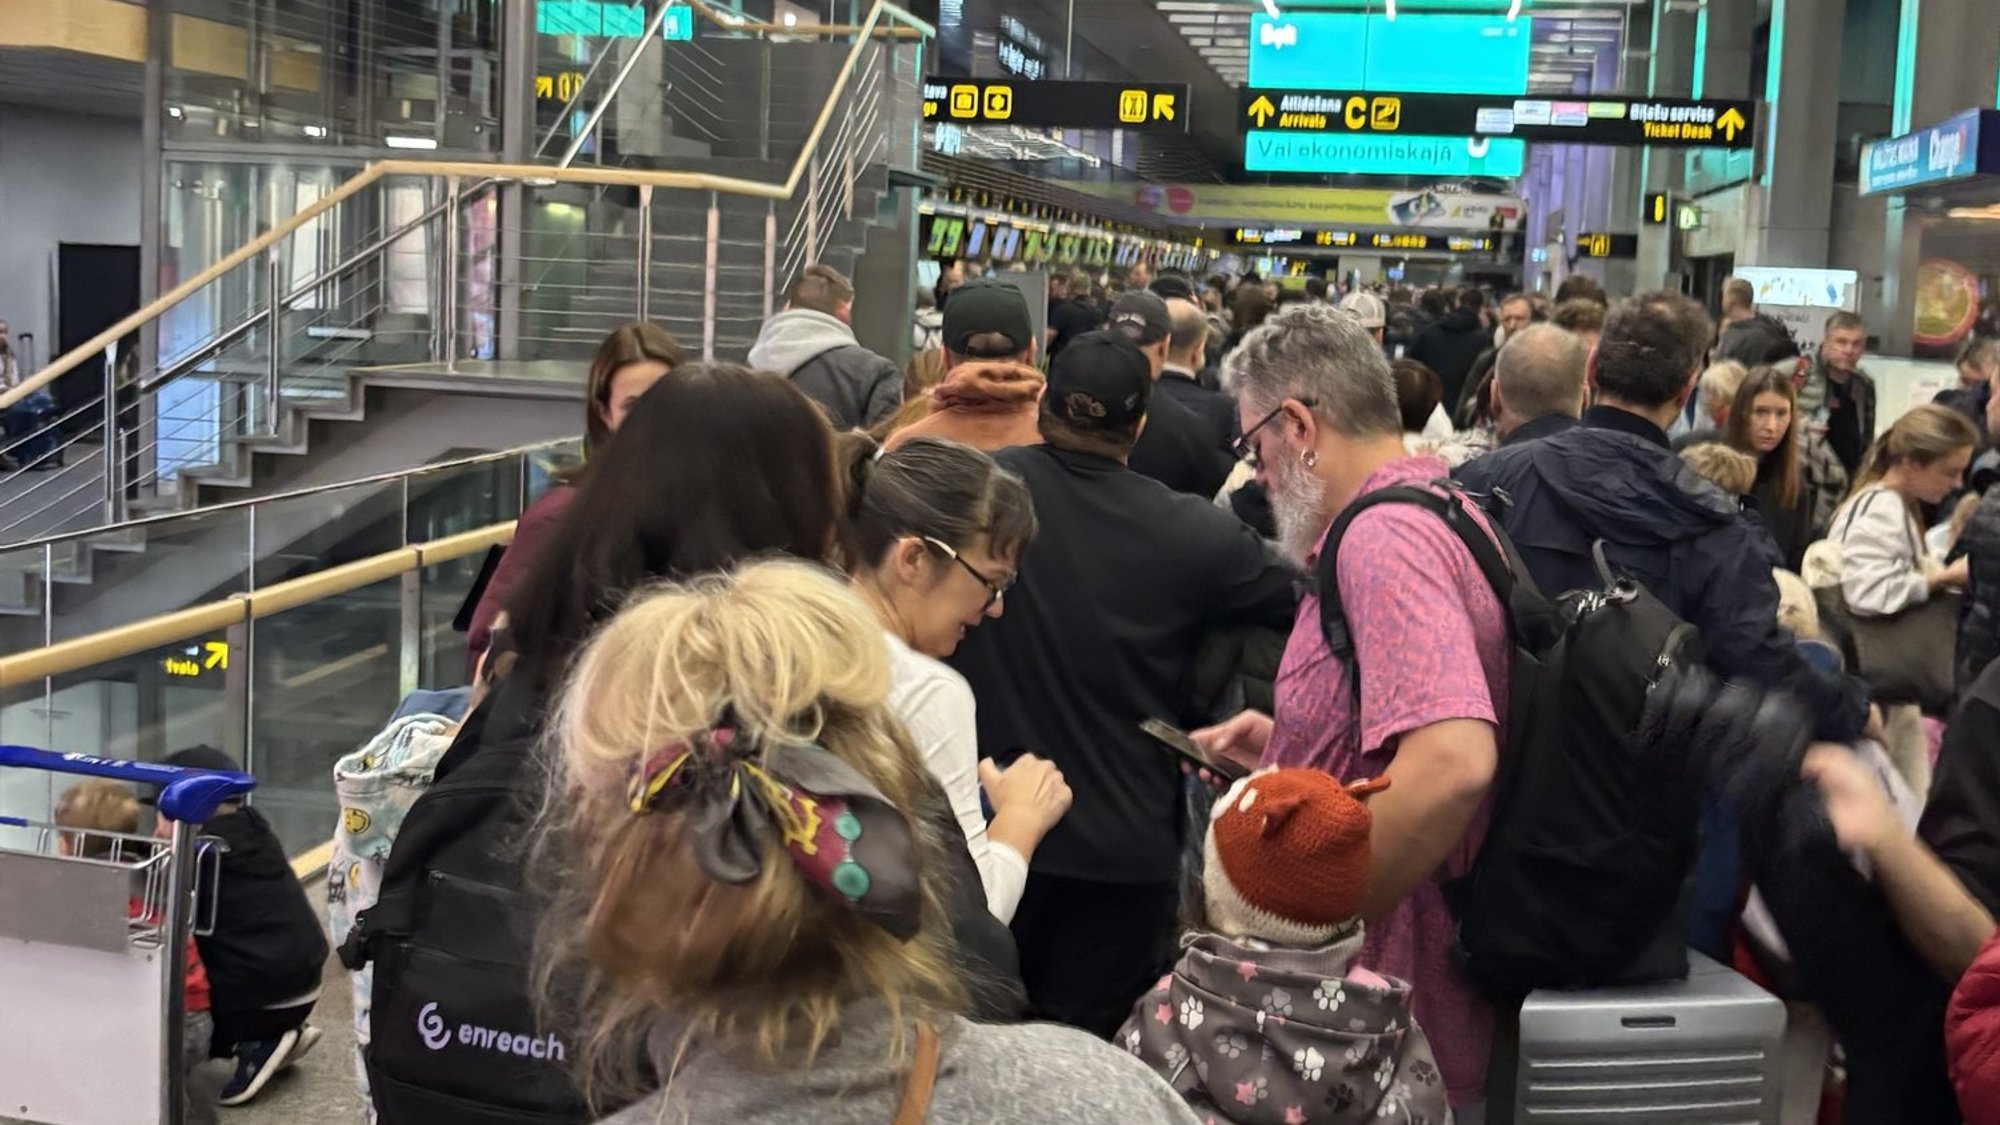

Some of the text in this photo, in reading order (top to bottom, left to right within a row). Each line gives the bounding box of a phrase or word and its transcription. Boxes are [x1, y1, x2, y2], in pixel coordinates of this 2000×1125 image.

[1279, 112, 1327, 129] Arrivals
[1344, 96, 1367, 129] C
[1643, 122, 1680, 139] Ticket
[458, 1023, 566, 1061] enreach
